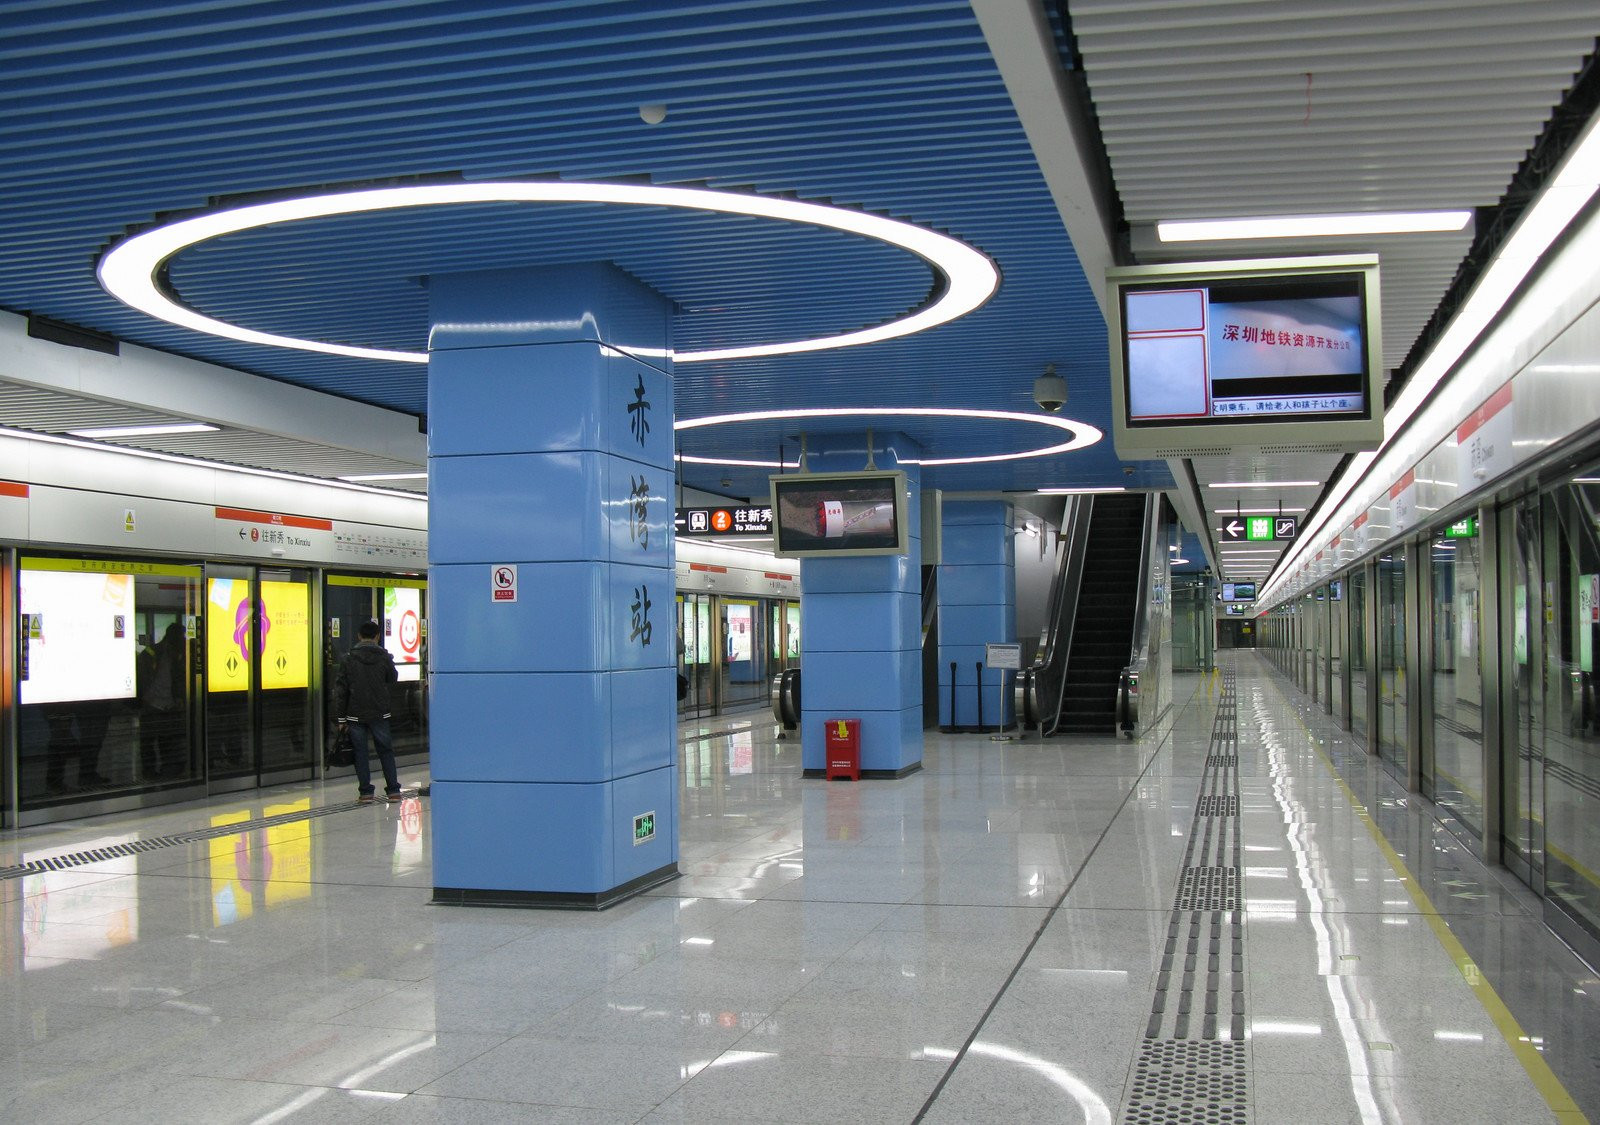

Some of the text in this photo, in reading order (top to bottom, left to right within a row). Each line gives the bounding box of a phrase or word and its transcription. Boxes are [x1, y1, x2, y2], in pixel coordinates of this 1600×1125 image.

[717, 512, 726, 523] 2
[734, 509, 773, 523] 往新秀
[735, 524, 744, 532] To
[262, 530, 285, 544] 往新秀
[287, 536, 294, 545] To
[294, 537, 311, 547] Xinxiu
